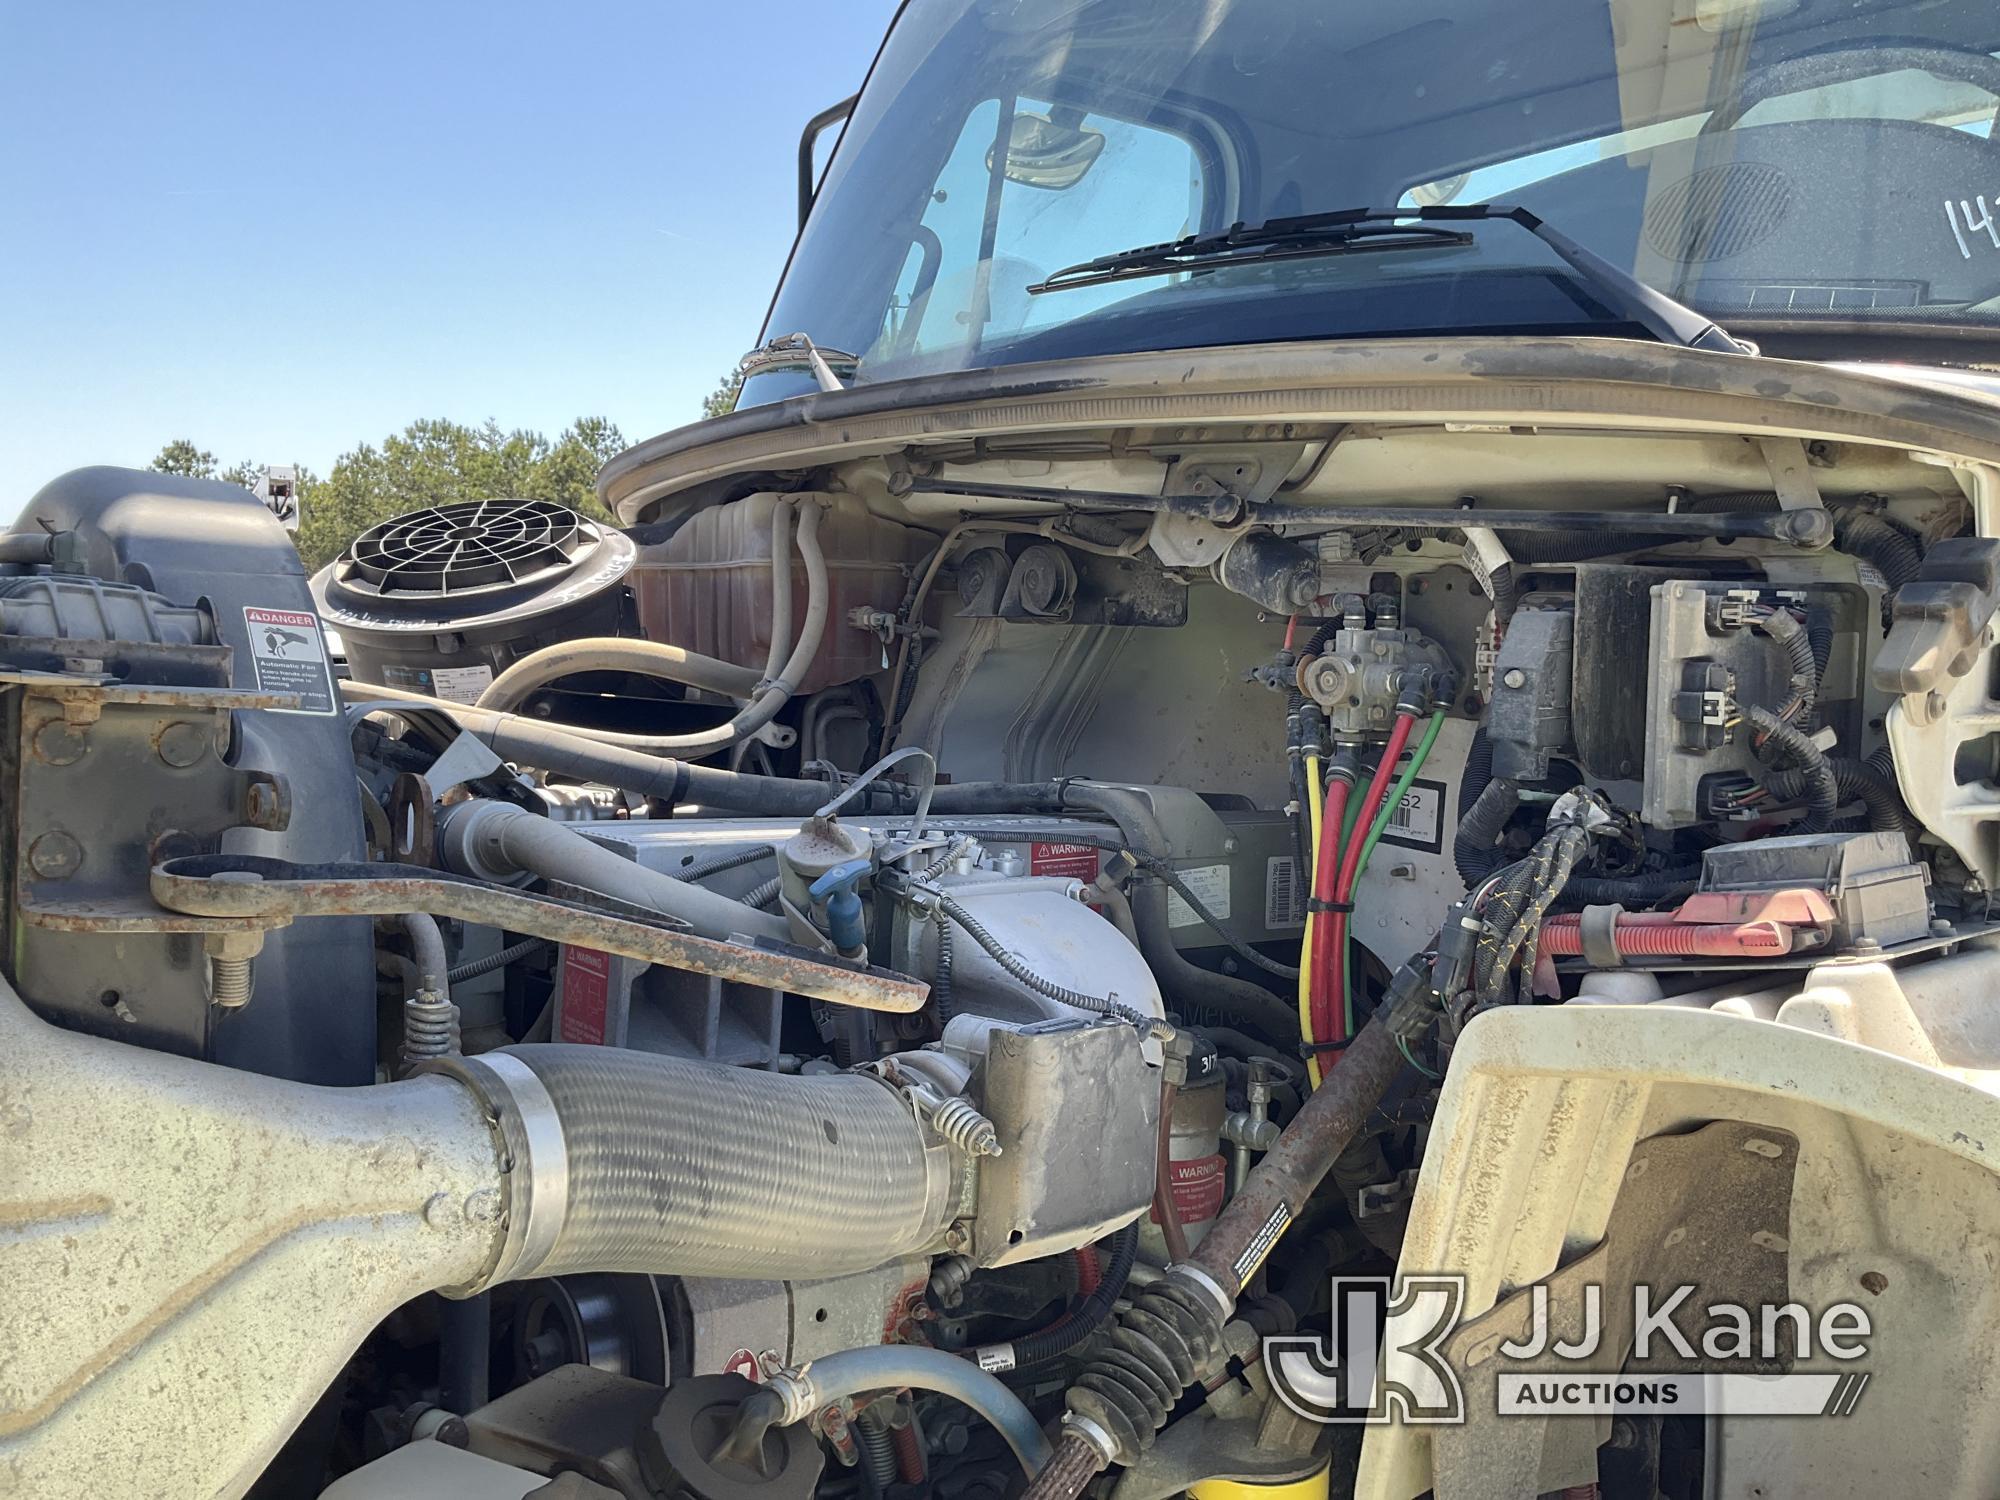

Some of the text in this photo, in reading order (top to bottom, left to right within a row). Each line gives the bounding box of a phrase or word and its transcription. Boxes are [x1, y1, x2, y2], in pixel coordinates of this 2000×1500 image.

[1944, 195, 2000, 259] 14
[262, 613, 313, 625] DANGER
[1050, 844, 1092, 855] WARNING
[576, 951, 602, 969] WARNING
